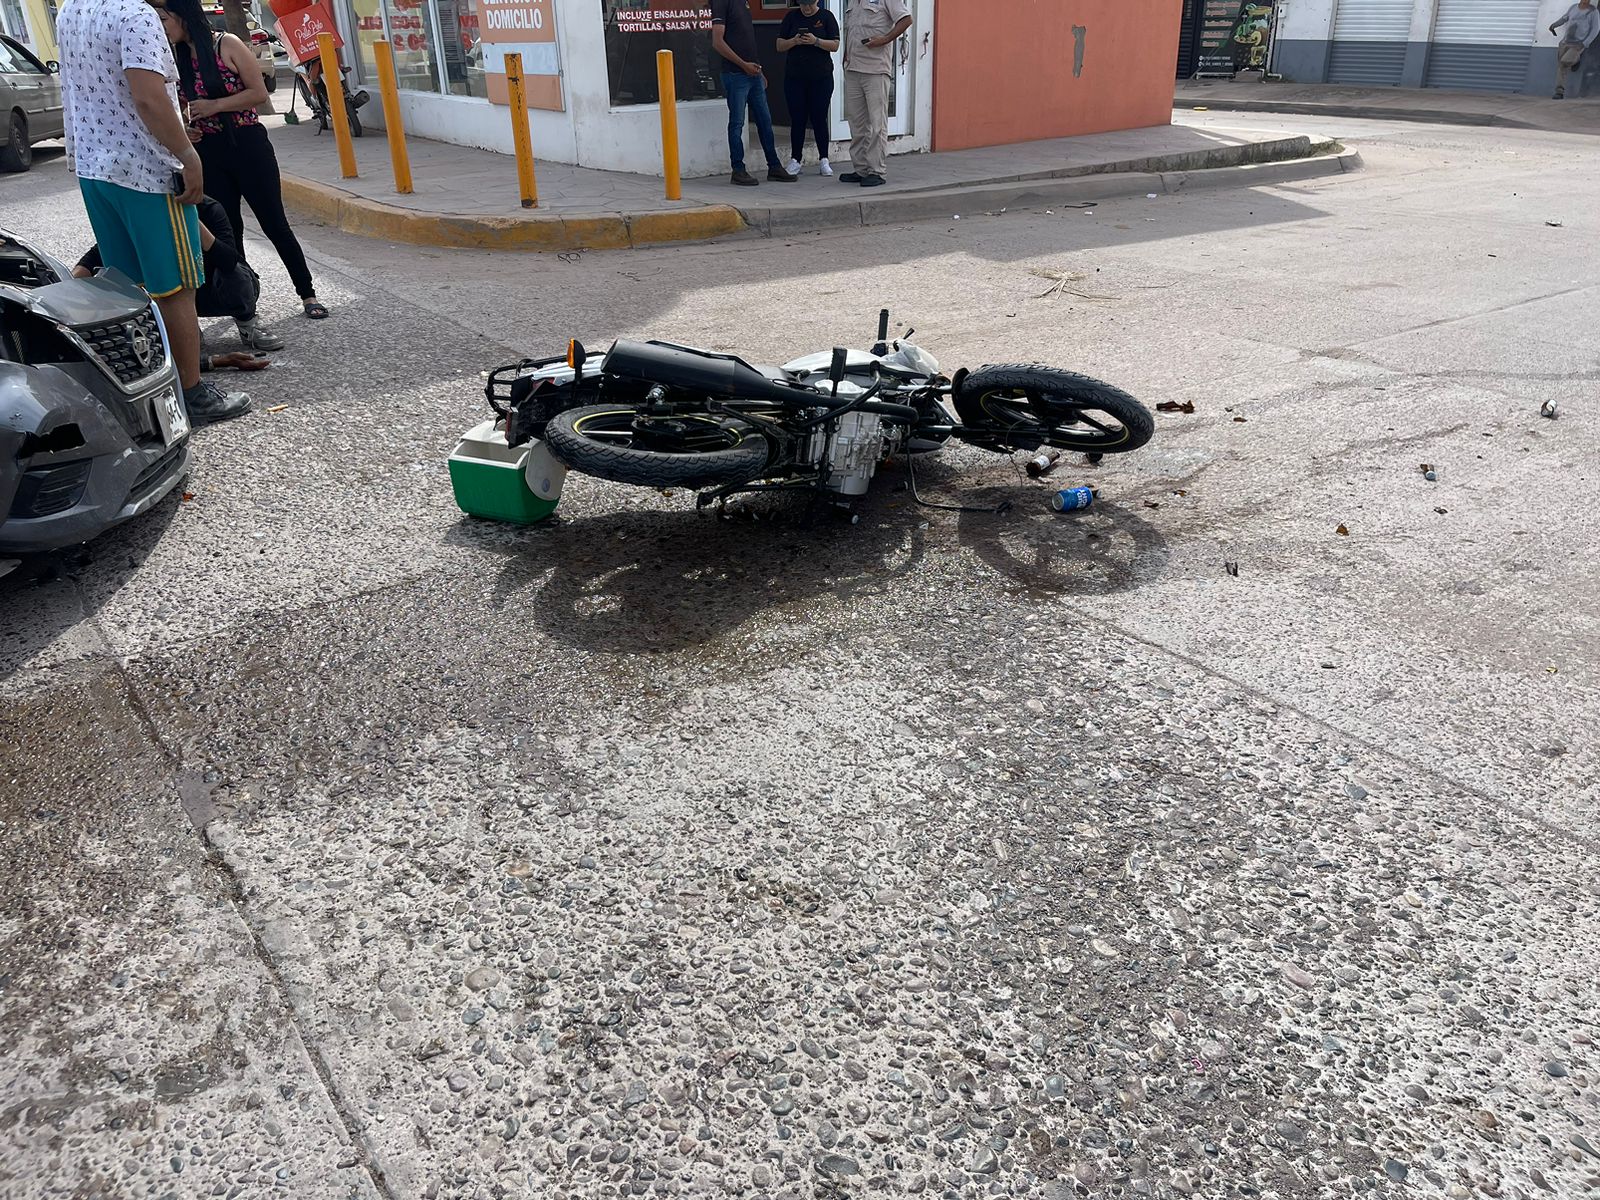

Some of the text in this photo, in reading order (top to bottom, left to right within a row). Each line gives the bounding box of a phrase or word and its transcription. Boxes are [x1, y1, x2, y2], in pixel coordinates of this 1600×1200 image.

[486, 8, 543, 29] DOMICILIO
[616, 10, 652, 21] INCLUYE
[653, 9, 697, 19] ENSALADA,
[617, 22, 665, 33] TORTILLAS,
[665, 20, 691, 31] SALSA
[691, 20, 698, 30] Y
